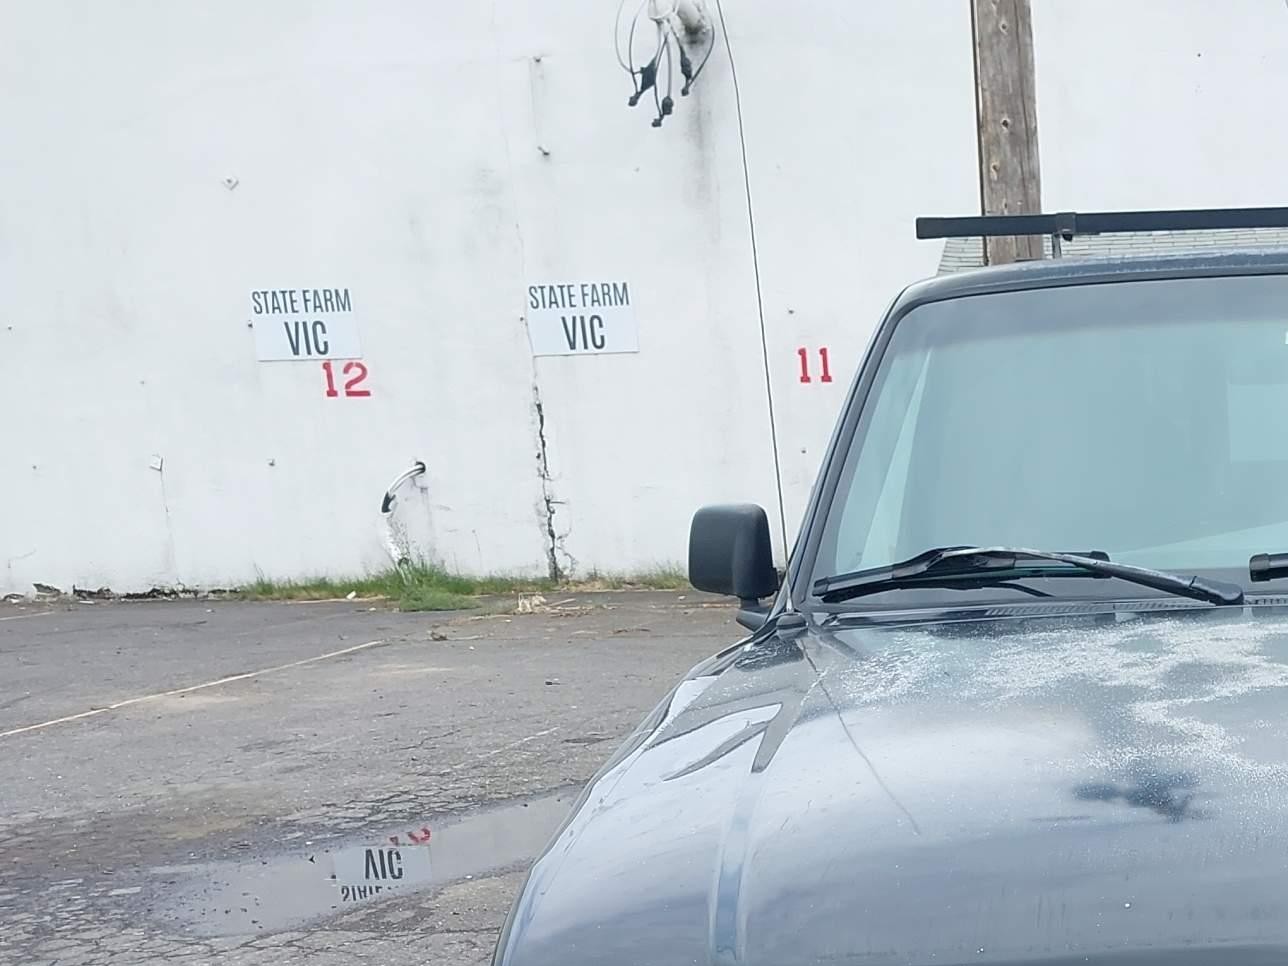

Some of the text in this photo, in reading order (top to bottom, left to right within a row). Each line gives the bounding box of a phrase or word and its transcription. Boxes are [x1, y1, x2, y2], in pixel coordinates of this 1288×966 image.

[251, 288, 352, 315] STATE FARM
[529, 281, 630, 310] STATE FARM
[283, 320, 329, 356] VIC
[560, 314, 606, 350] VIC
[322, 360, 371, 397] 12
[796, 348, 833, 383] 11
